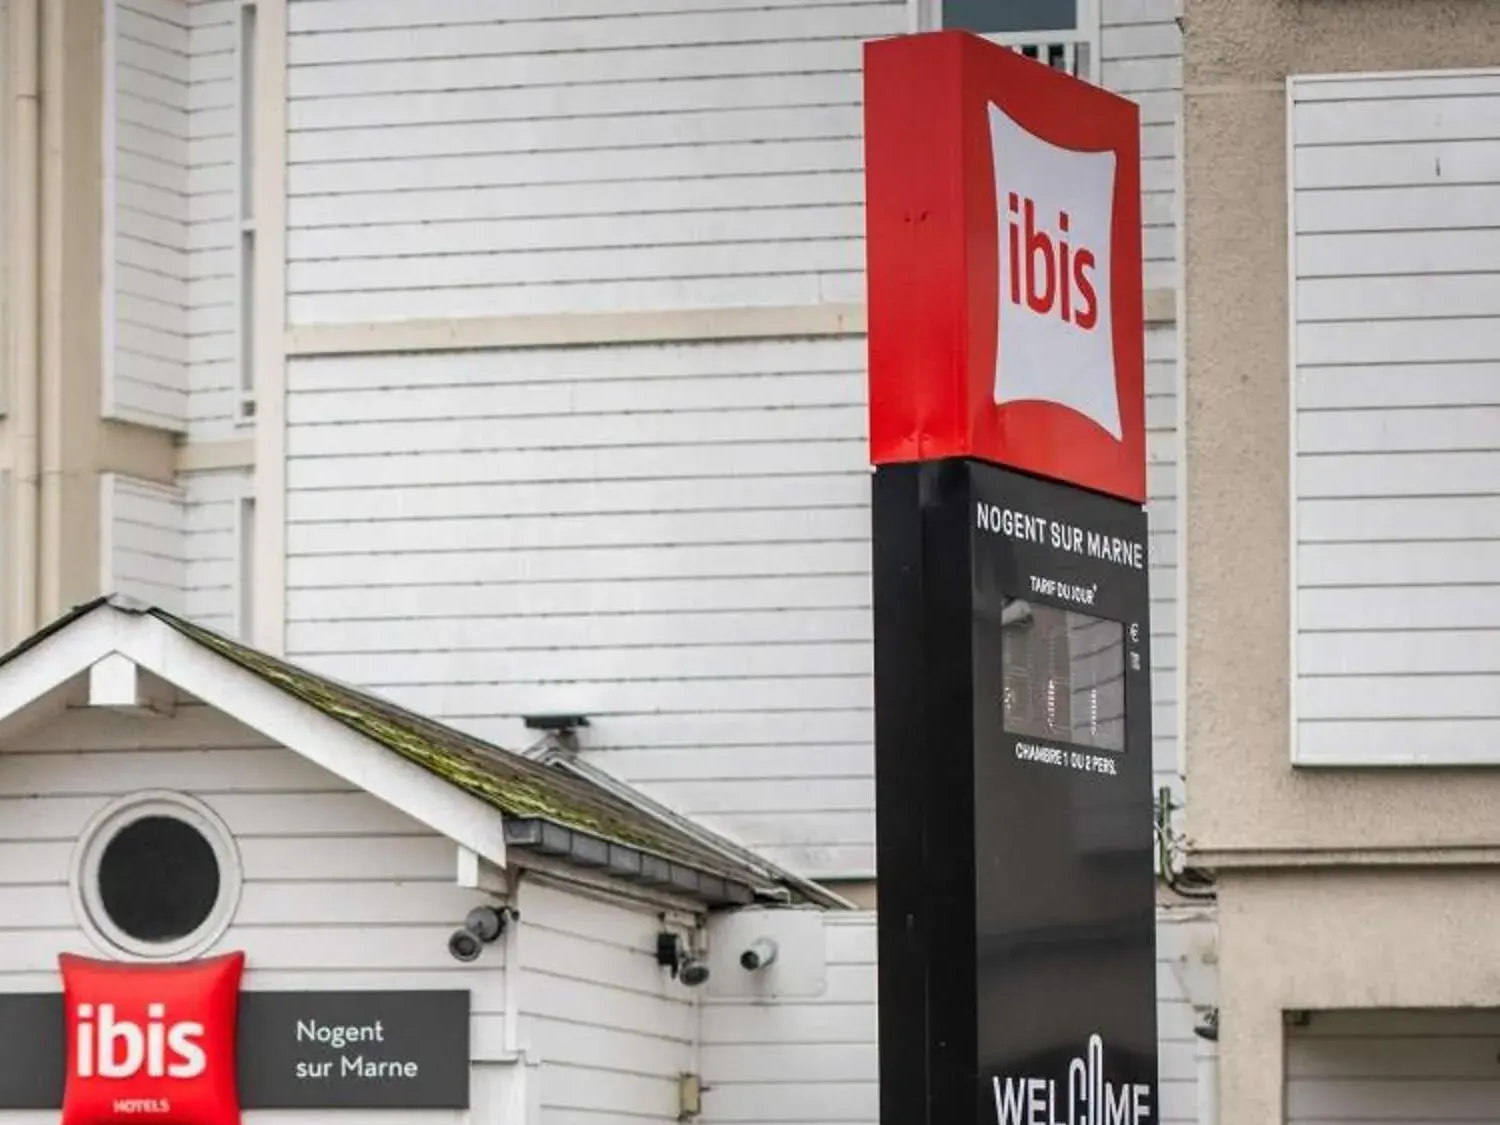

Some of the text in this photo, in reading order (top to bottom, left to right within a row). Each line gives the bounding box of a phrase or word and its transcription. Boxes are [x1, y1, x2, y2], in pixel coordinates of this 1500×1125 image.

[1008, 191, 1099, 330] ibis
[976, 501, 1143, 570] NOGENT SUR MARNE
[1029, 575, 1056, 596] TARIF
[1057, 581, 1071, 600] DU
[1015, 741, 1062, 766] CHAMBRE
[1070, 751, 1085, 770] OU
[76, 1003, 207, 1079] ibis
[296, 1020, 385, 1048] Nogent
[296, 1055, 419, 1078] sur Marne
[113, 1098, 171, 1114] HOTELS
